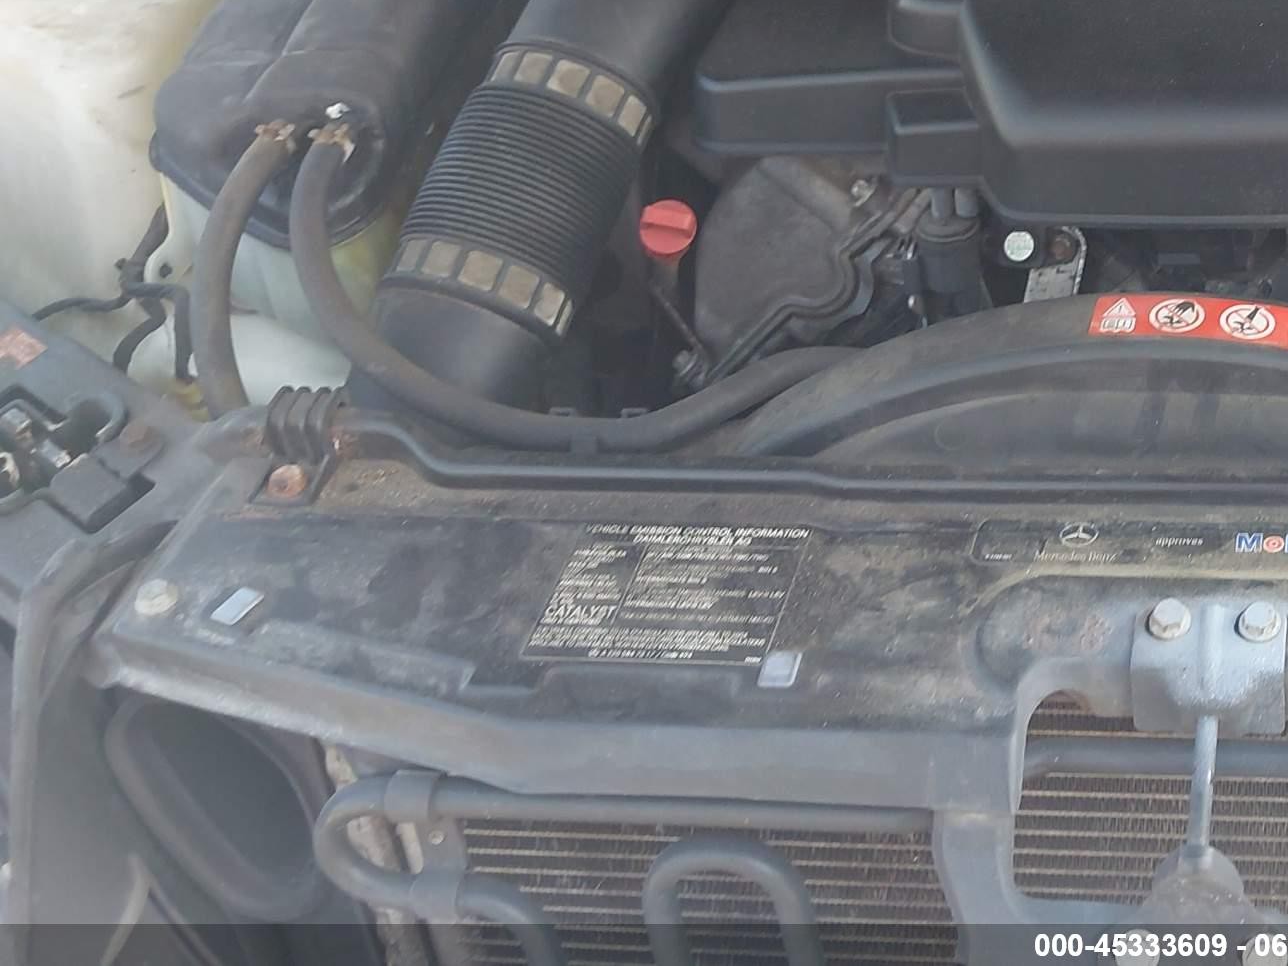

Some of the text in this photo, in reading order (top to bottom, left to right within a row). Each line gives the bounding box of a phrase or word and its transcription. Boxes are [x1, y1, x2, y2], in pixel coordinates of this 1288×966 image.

[587, 525, 811, 539] VEHICLE EMISSION CONTROL INFORMATION
[1154, 536, 1205, 547] approves
[544, 605, 618, 618] CATALYST
